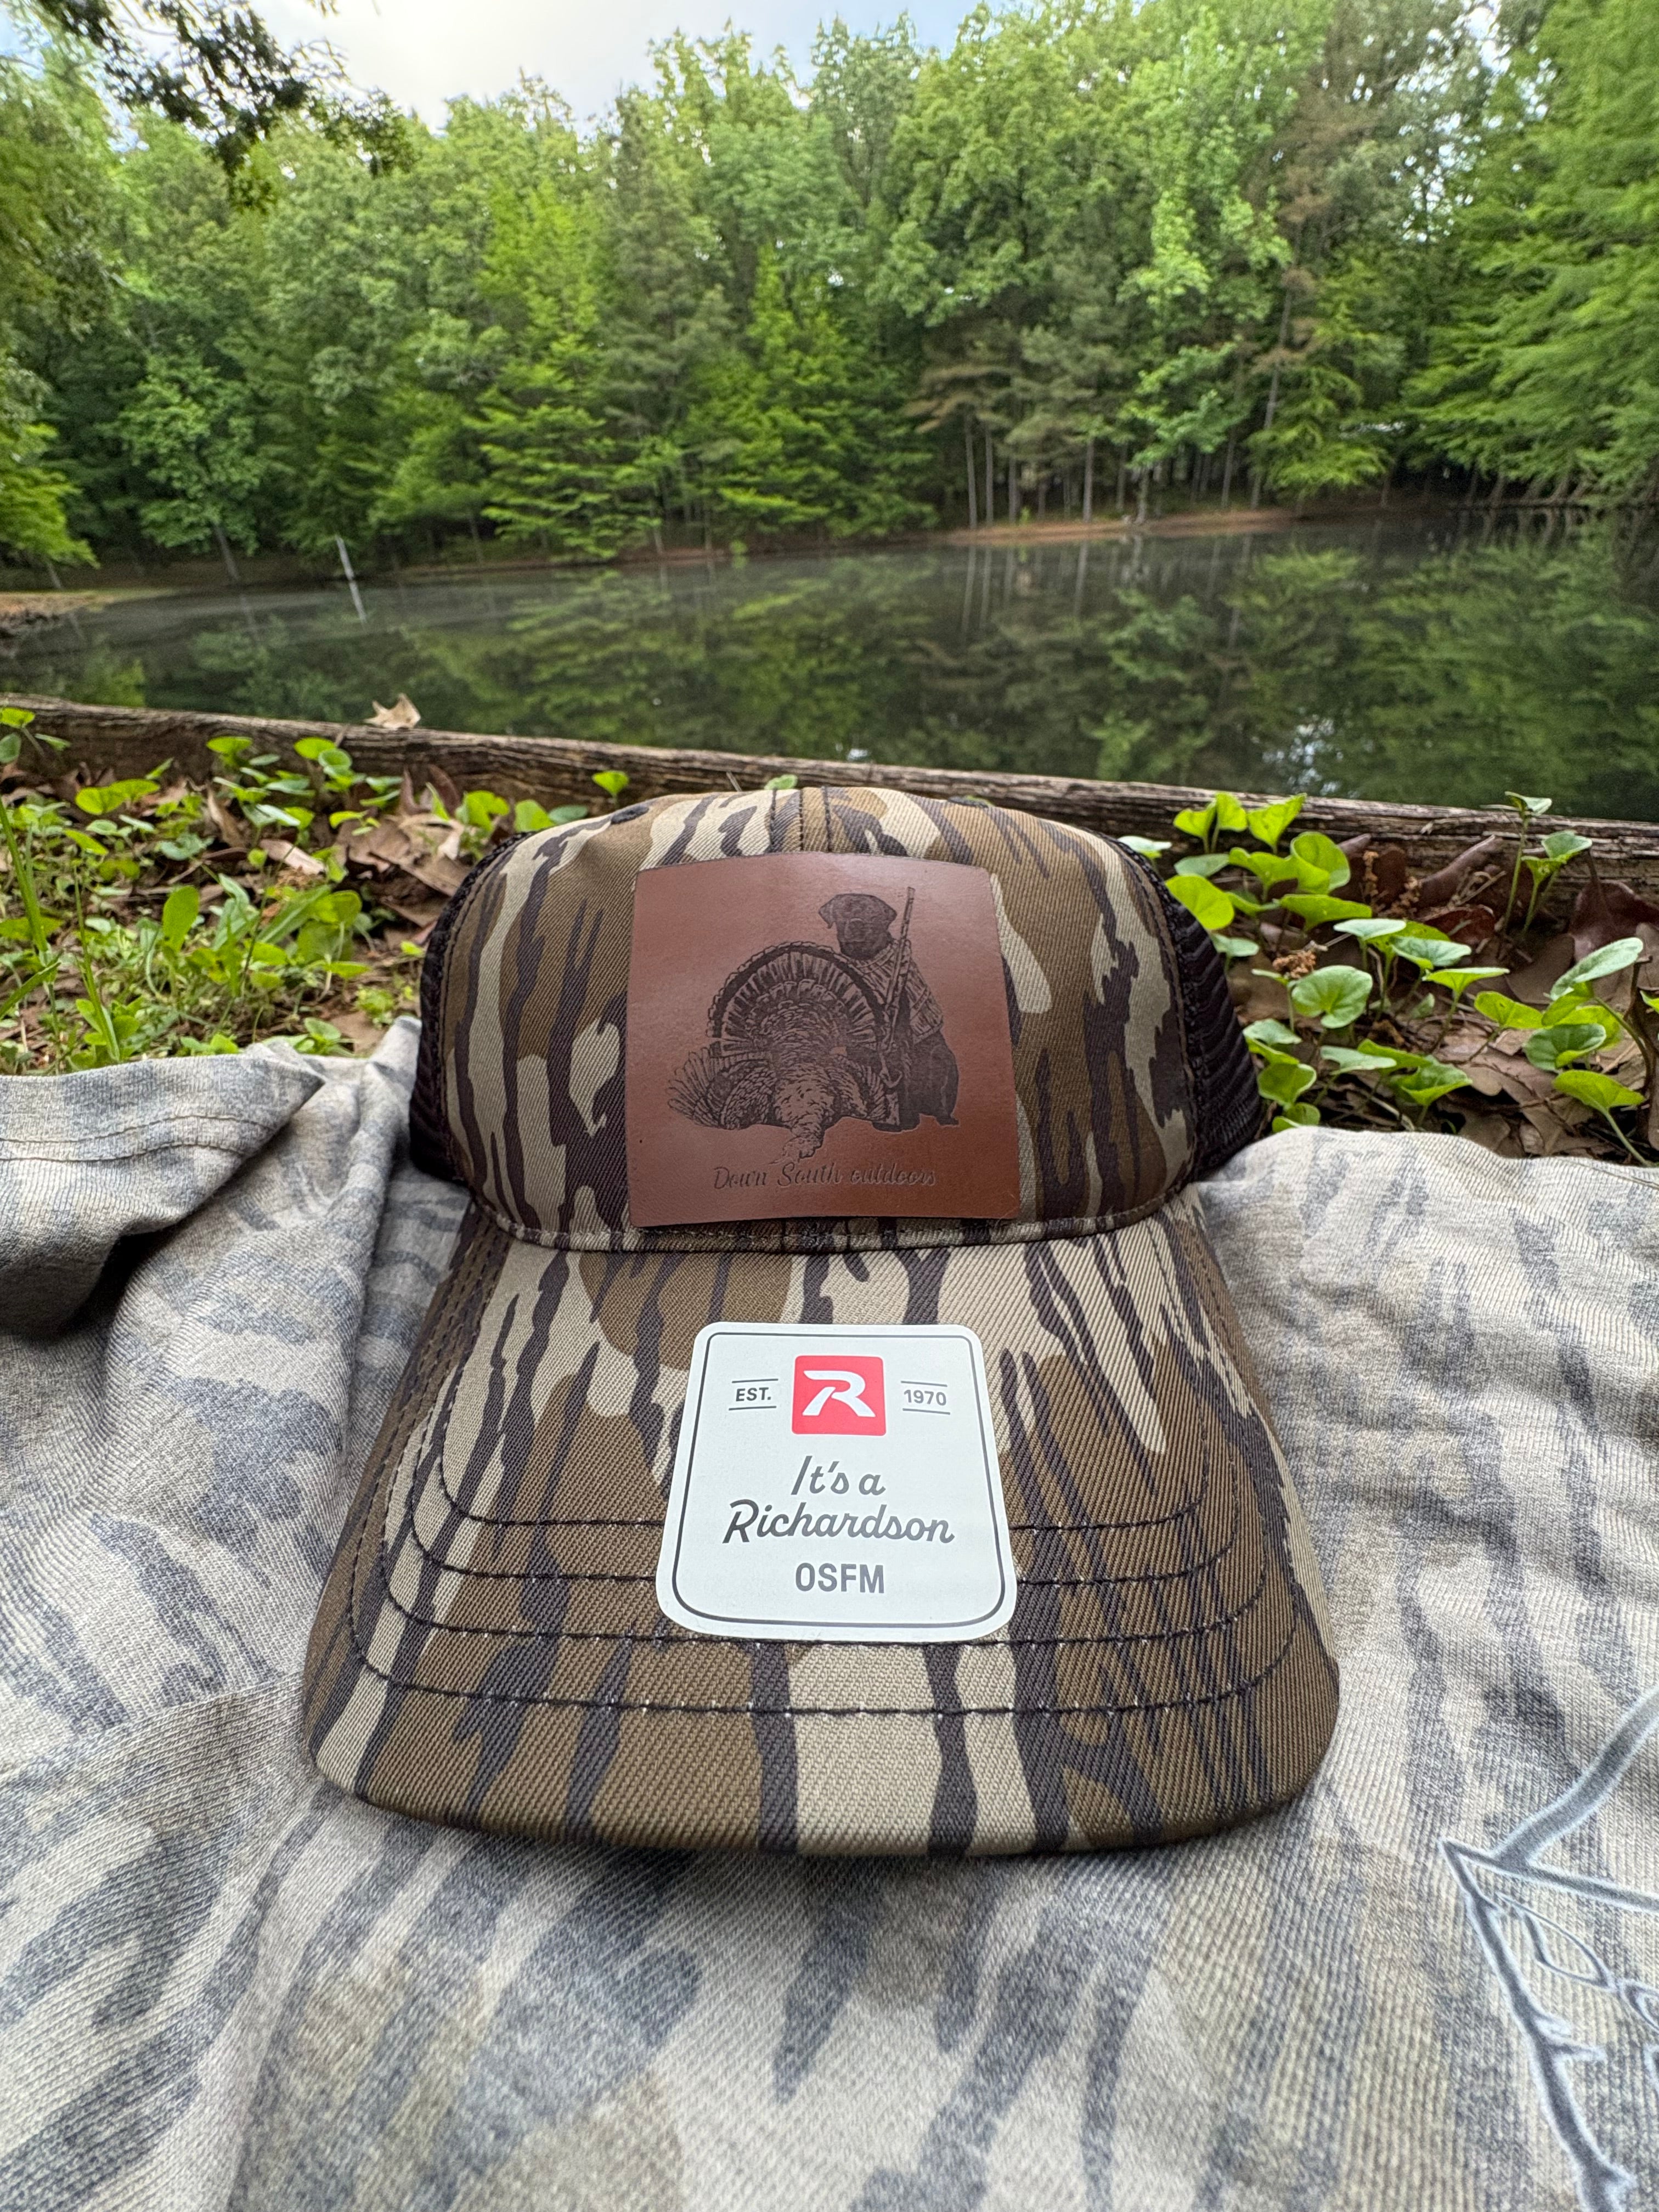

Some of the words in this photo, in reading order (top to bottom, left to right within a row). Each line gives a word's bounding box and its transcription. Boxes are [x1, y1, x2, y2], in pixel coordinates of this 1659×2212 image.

[714, 1166, 768, 1190] Down
[777, 1162, 843, 1187] South
[735, 1387, 772, 1402] EST.
[903, 1389, 947, 1407] 1970
[791, 1455, 850, 1496] It's
[859, 1474, 887, 1496] a
[722, 1498, 955, 1544] Richardson
[795, 1562, 885, 1594] OSFM
